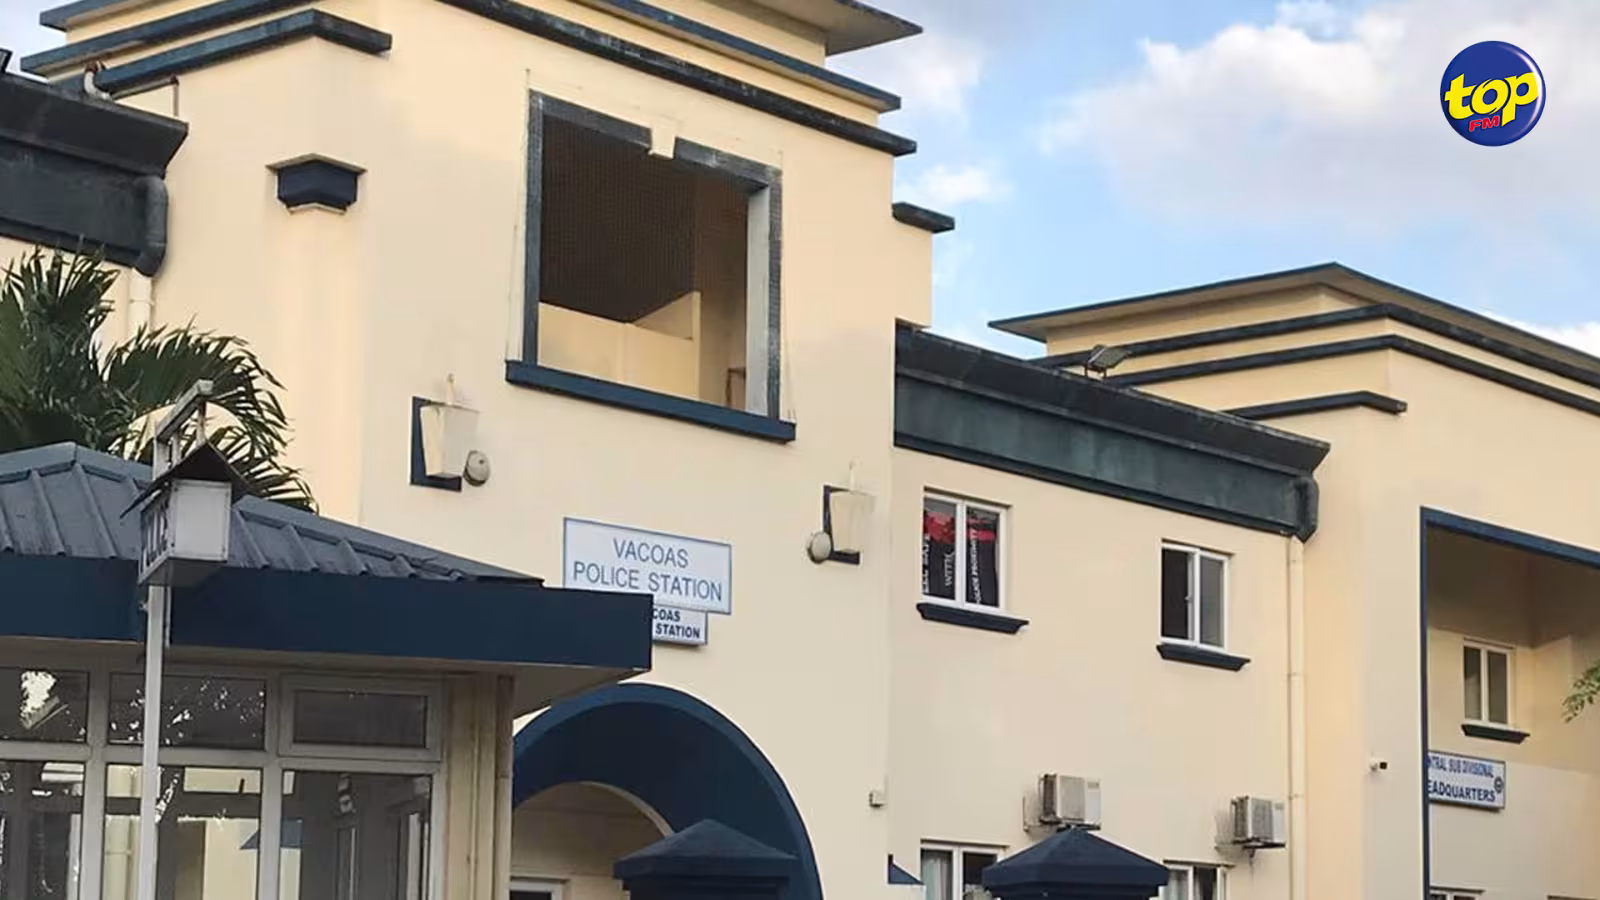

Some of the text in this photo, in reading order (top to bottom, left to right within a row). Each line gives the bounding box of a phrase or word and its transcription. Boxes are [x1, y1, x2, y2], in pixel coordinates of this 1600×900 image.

[613, 538, 689, 569] VACOAS
[573, 561, 722, 602] POLICE STATION
[652, 608, 681, 622] COAS
[655, 623, 700, 639] STATION
[1427, 780, 1496, 802] EADQUARTERS
